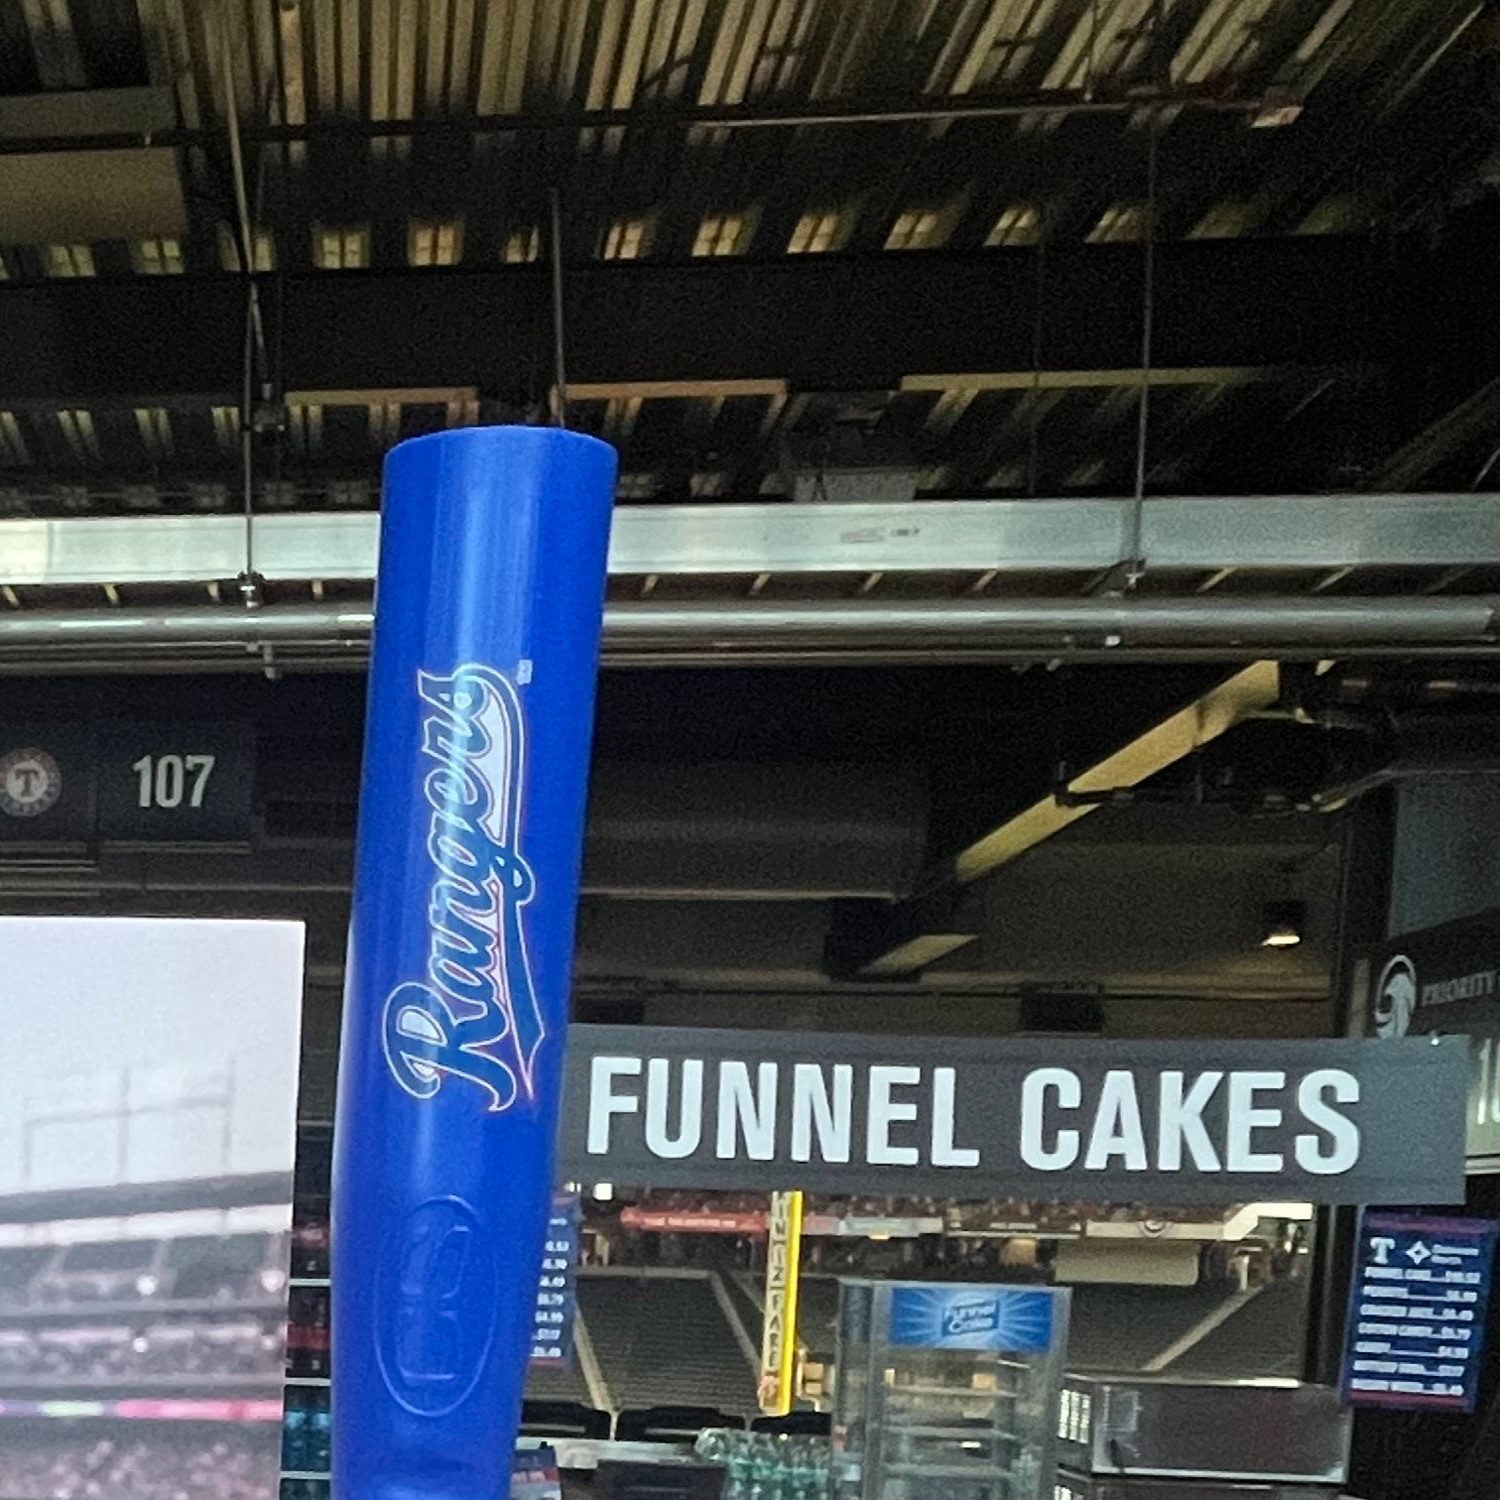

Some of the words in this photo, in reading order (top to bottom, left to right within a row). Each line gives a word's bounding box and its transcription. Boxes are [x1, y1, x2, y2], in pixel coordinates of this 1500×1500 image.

[132, 754, 215, 808] 107
[382, 662, 546, 1113] Rangers
[586, 1055, 982, 1169] FUNNEL
[1019, 1067, 1361, 1177] CAKES
